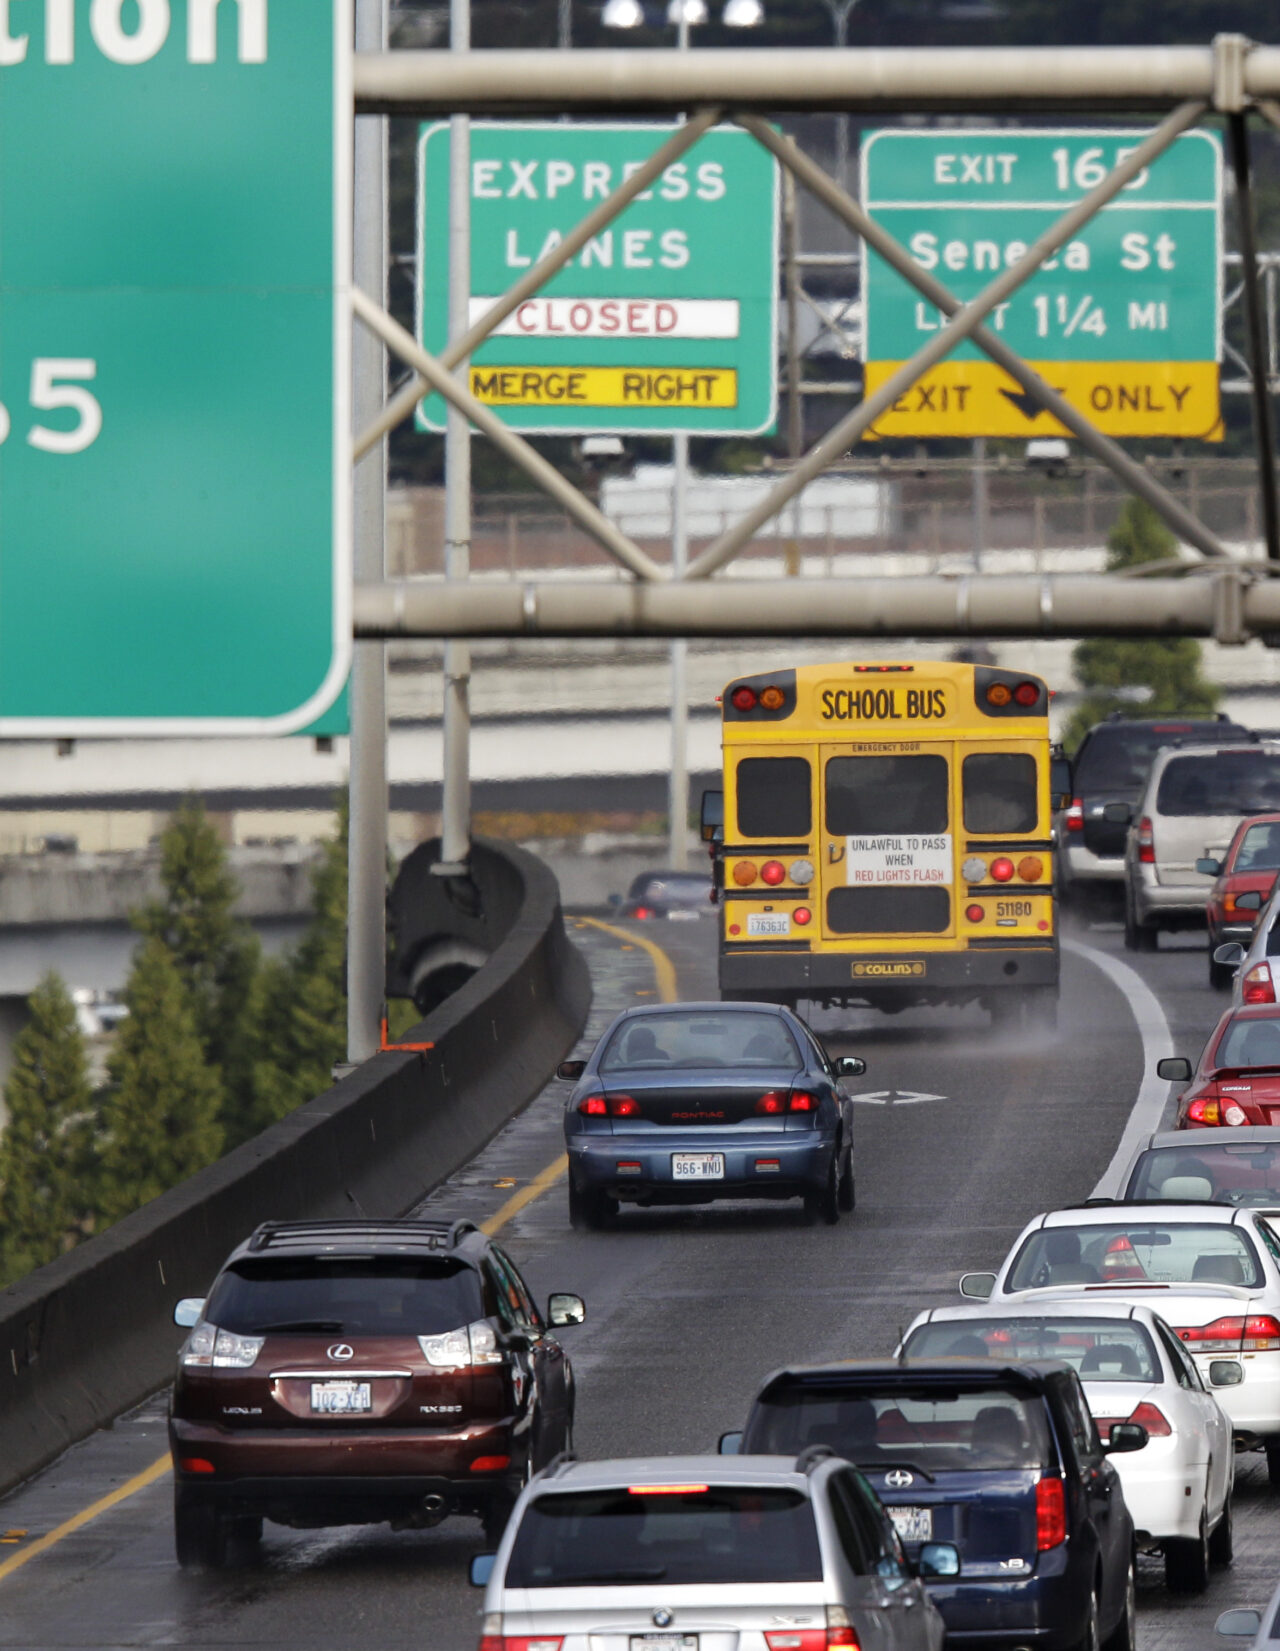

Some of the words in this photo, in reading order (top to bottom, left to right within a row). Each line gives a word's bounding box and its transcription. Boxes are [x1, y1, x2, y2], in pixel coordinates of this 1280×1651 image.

[472, 160, 727, 201] EXPRESS
[934, 154, 1018, 185] EXIT
[1052, 148, 1149, 190] 165
[506, 229, 690, 268] LANES
[1120, 233, 1176, 271] St
[516, 303, 678, 333] CLOSED
[915, 302, 1011, 330] LT
[1128, 302, 1168, 330] MI
[472, 373, 587, 399] MERGE
[623, 374, 719, 400] RIGHT
[1090, 385, 1191, 412] ONLY
[0, 358, 102, 454] 5
[822, 689, 902, 719] SCHOOL
[907, 689, 946, 719] BUS
[852, 743, 896, 752] EMERGENCY
[900, 743, 920, 751] DOOR
[852, 839, 903, 851] UNLAWFUL
[906, 839, 919, 850] TO
[922, 838, 946, 850] PASS
[885, 854, 913, 866] WHEN
[855, 870, 873, 881] RED
[877, 870, 910, 881] LIGHTS
[914, 869, 944, 880] FLASH
[997, 901, 1032, 916] 51180
[866, 964, 911, 975] COLLINS
